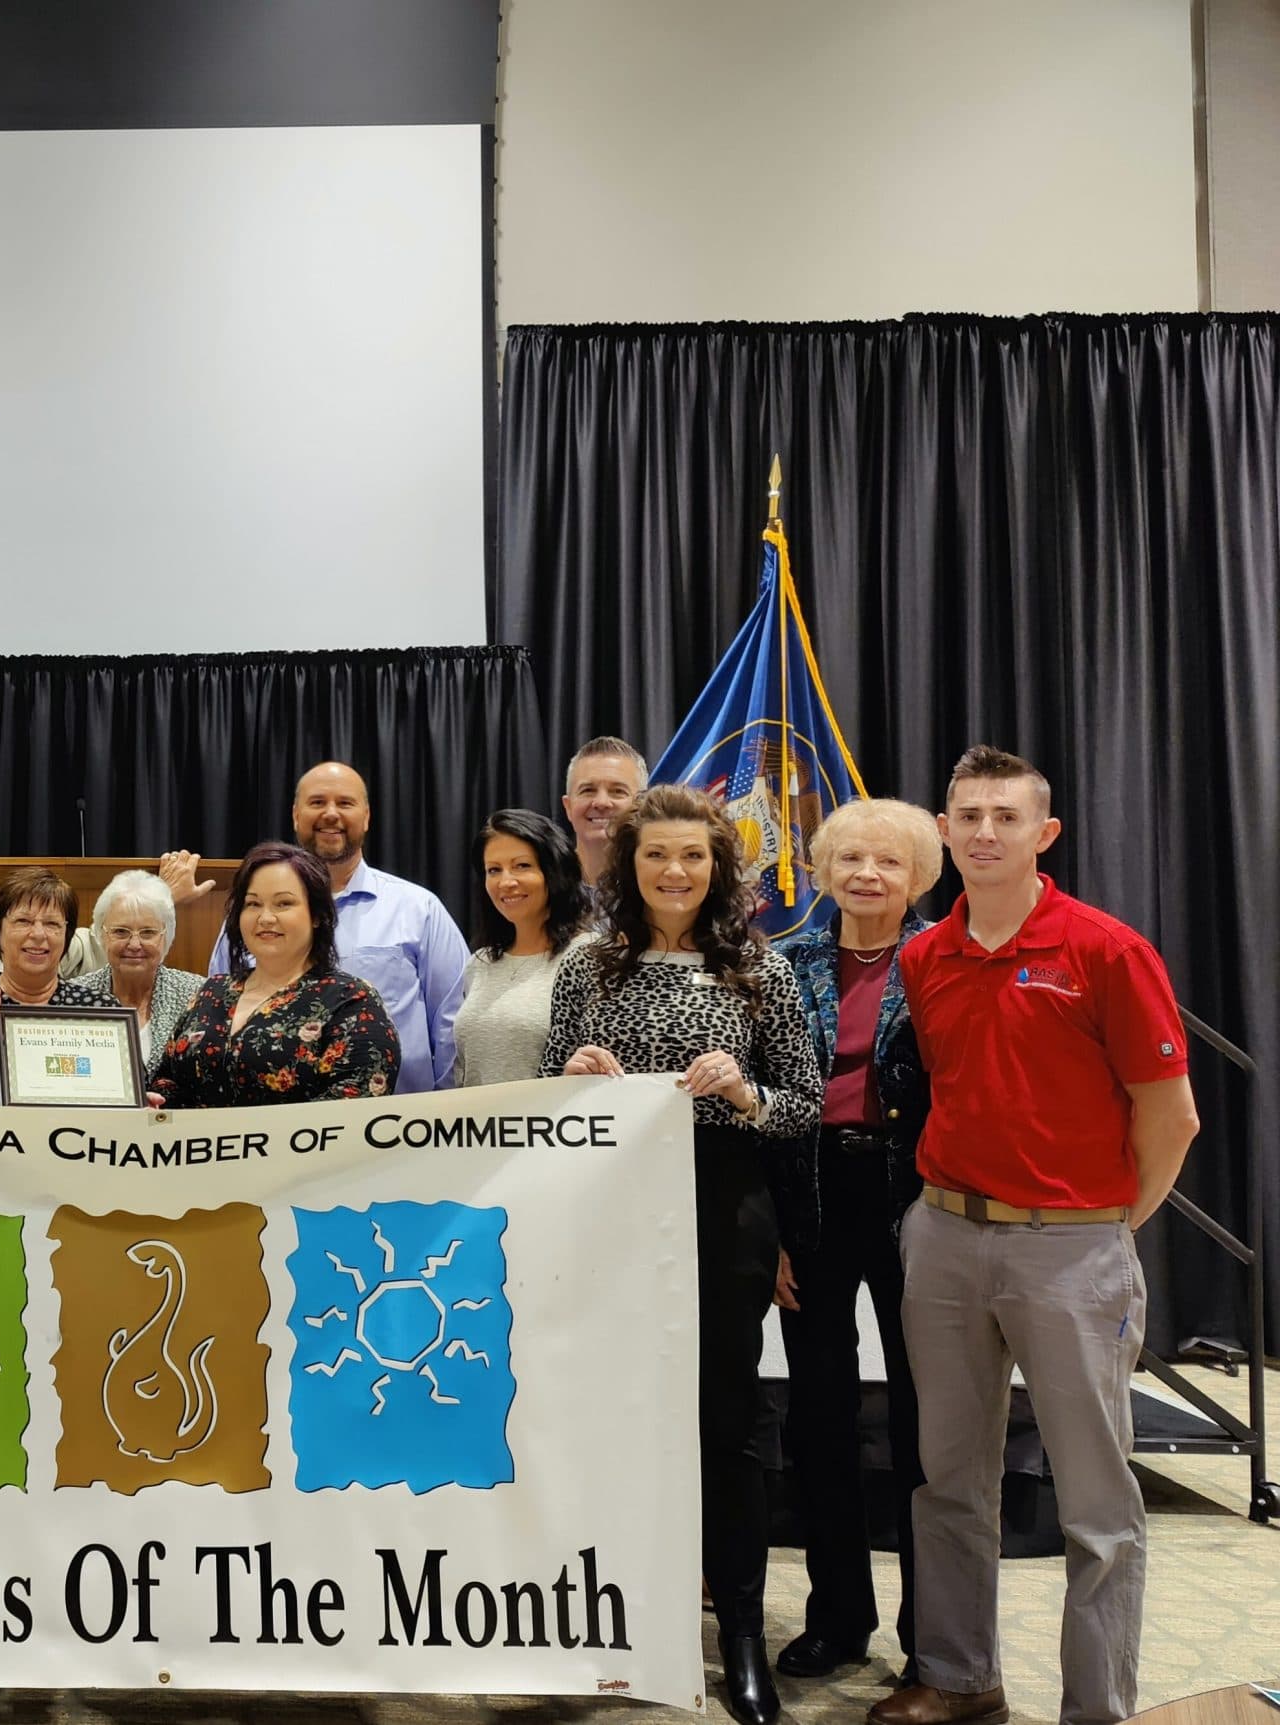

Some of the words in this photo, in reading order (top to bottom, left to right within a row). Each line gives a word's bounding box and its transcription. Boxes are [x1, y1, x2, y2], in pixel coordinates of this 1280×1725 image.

[20, 1037, 48, 1047] Evans
[50, 1037, 82, 1049] Family
[85, 1038, 115, 1048] Media
[48, 1127, 269, 1169] CHAMBER
[289, 1126, 345, 1155] OF
[364, 1115, 617, 1149] COMMERCE
[64, 1540, 166, 1645] Of
[195, 1541, 345, 1647] The
[374, 1546, 633, 1651] Month
